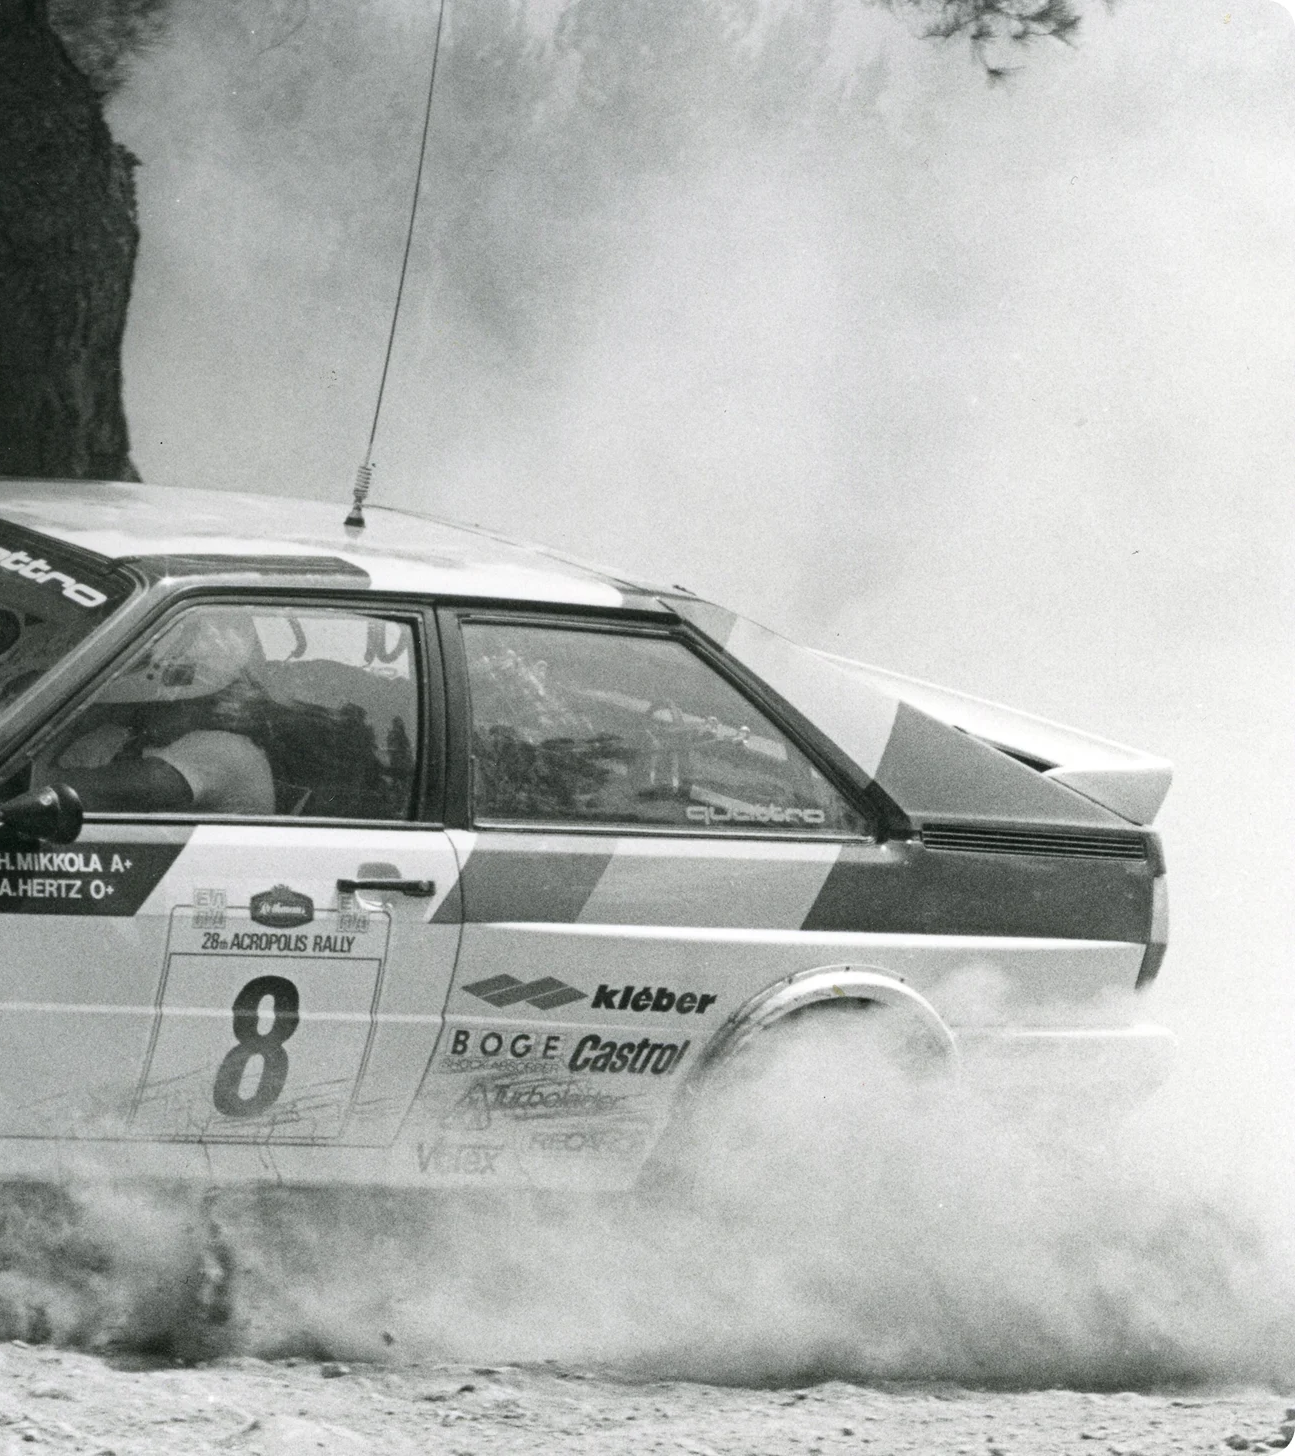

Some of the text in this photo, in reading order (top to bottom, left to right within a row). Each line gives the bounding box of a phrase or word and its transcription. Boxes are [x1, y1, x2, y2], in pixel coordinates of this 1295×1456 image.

[685, 803, 825, 825] quattro
[110, 854, 133, 872] A+
[201, 932, 356, 953] 28th ACROPOLIS RALLY
[590, 984, 718, 1014] kléber
[212, 975, 300, 1118] 8
[450, 1029, 561, 1060] BOGE
[568, 1033, 691, 1075] Castrol
